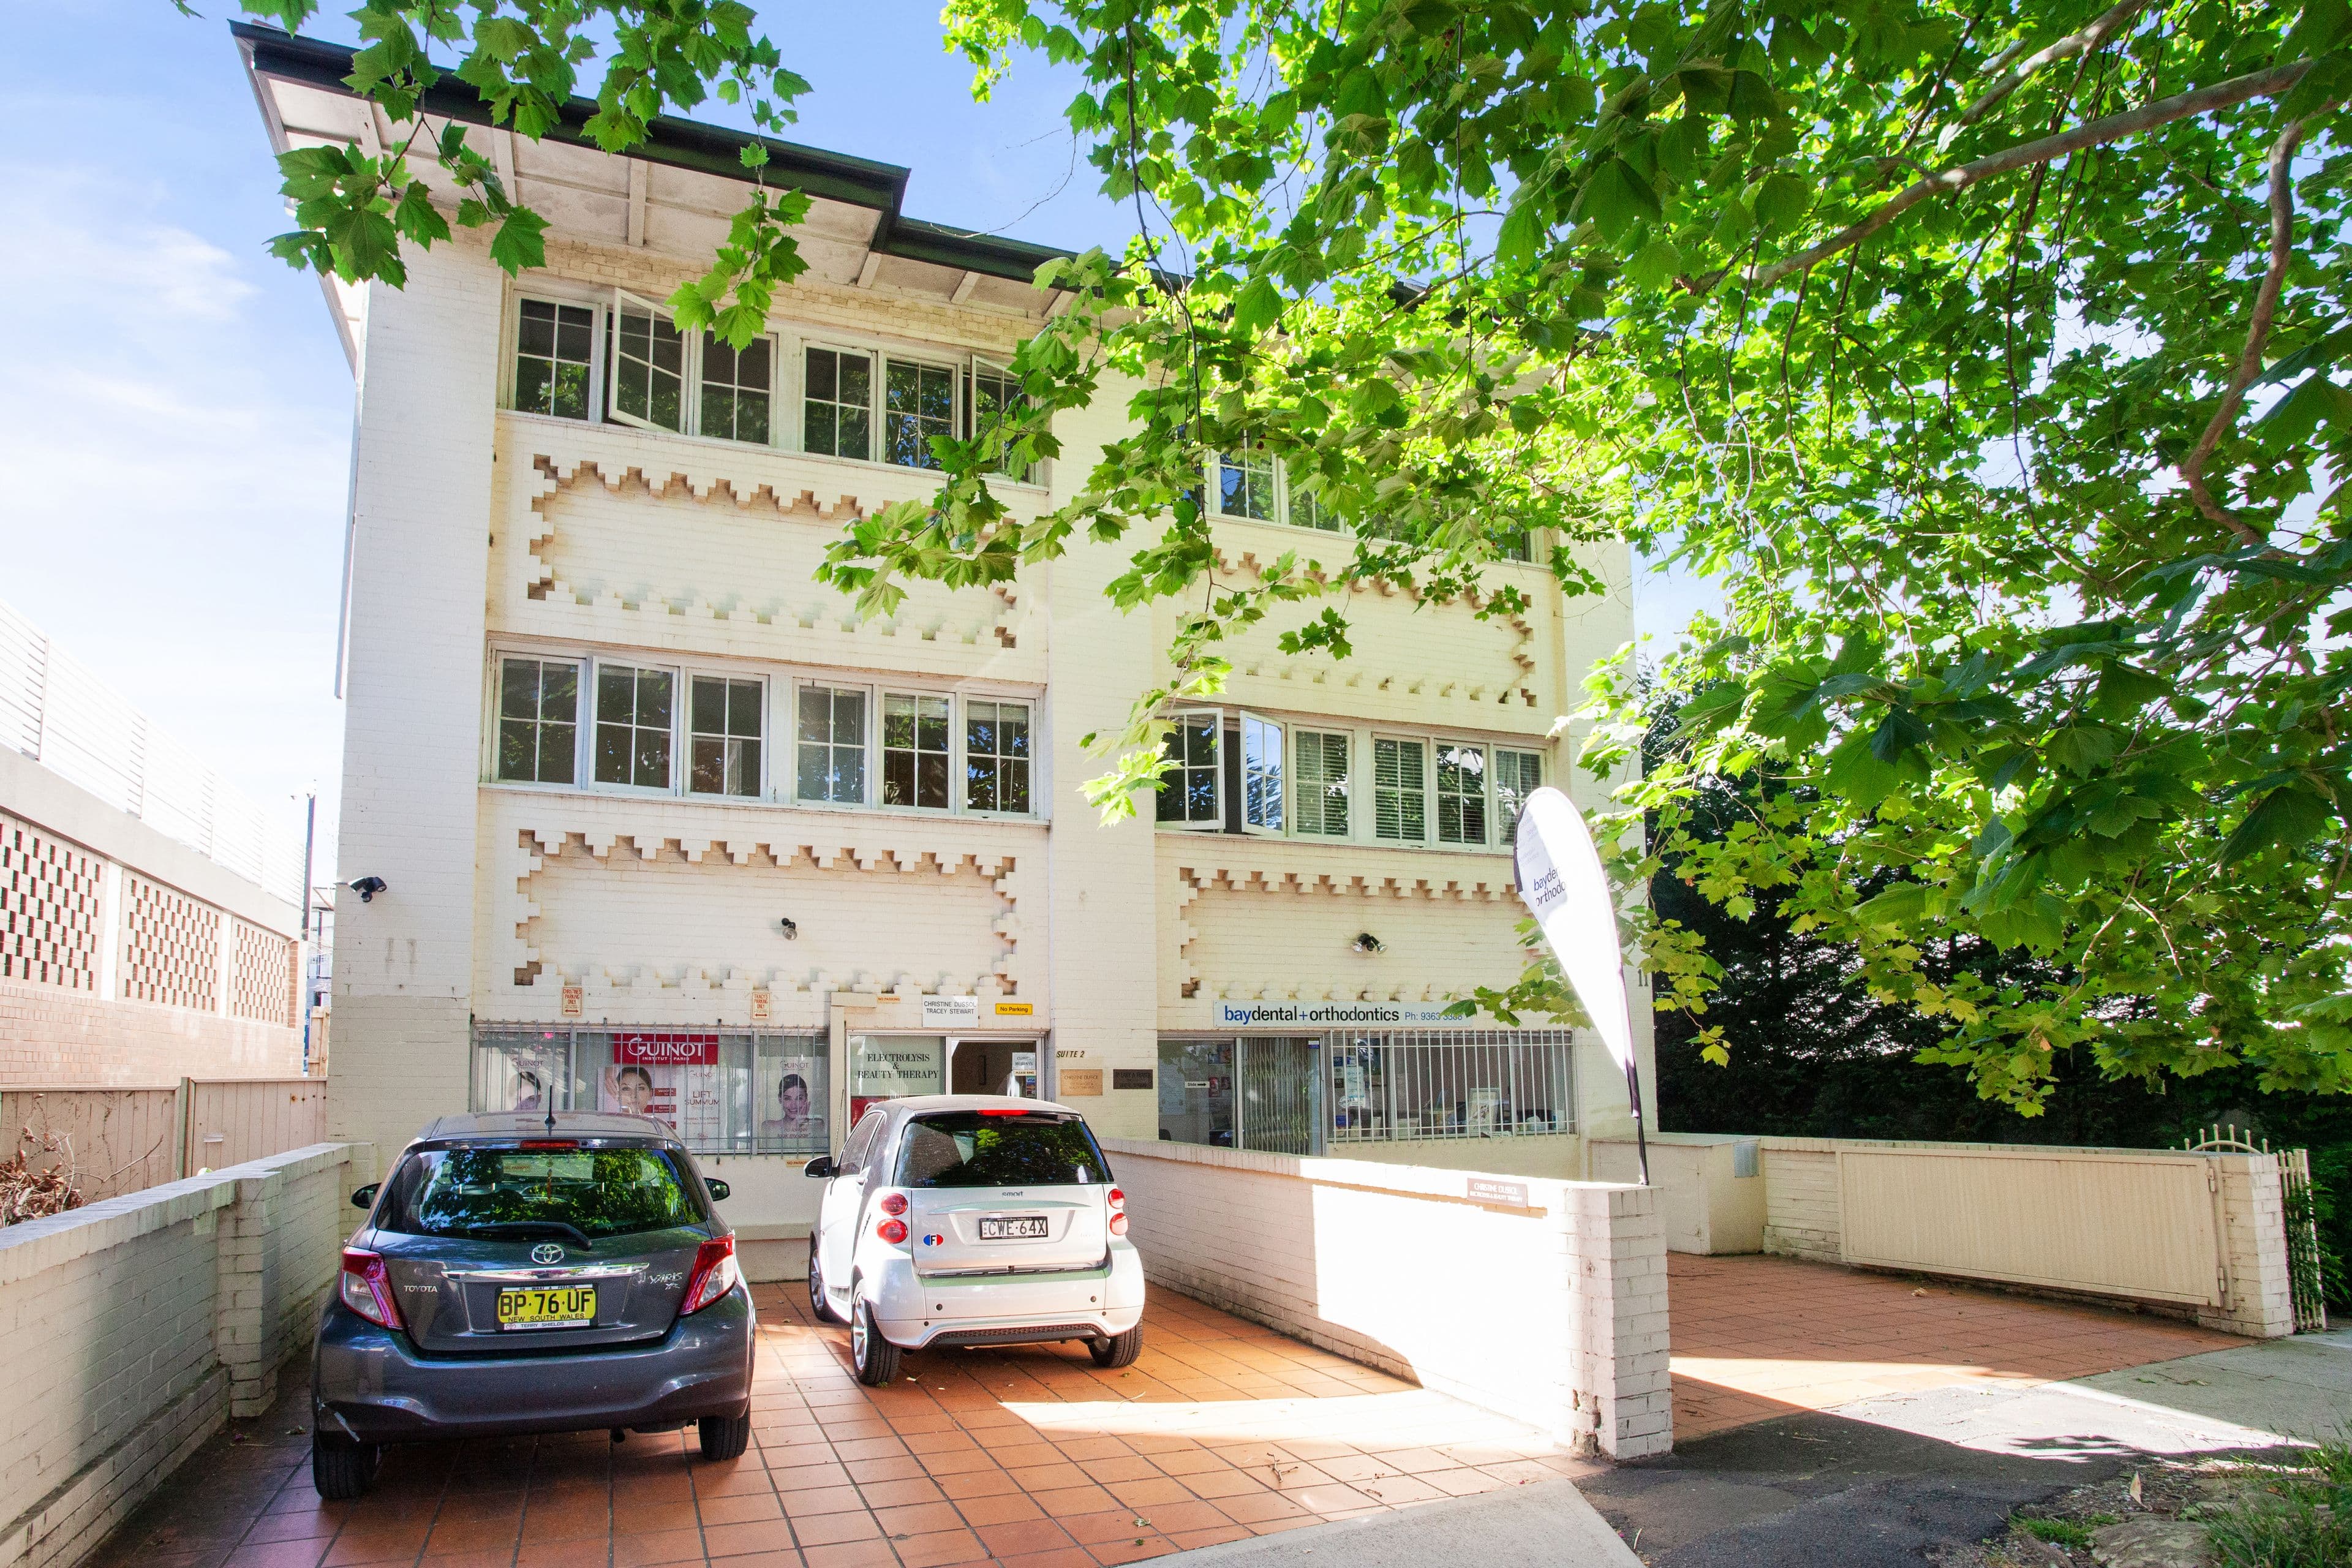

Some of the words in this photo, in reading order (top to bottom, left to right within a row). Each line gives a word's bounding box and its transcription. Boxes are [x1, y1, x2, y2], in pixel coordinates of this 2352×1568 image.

[1404, 1012, 1419, 1020] Ph:
[1420, 1012, 1441, 1020] 9363
[627, 1037, 704, 1057] GUINOT
[867, 1054, 930, 1062] ELECTROLYSIS
[892, 1061, 900, 1070] &
[858, 1070, 893, 1079] BEAUTY
[897, 1070, 939, 1079] THERAPY
[930, 1235, 937, 1245] F
